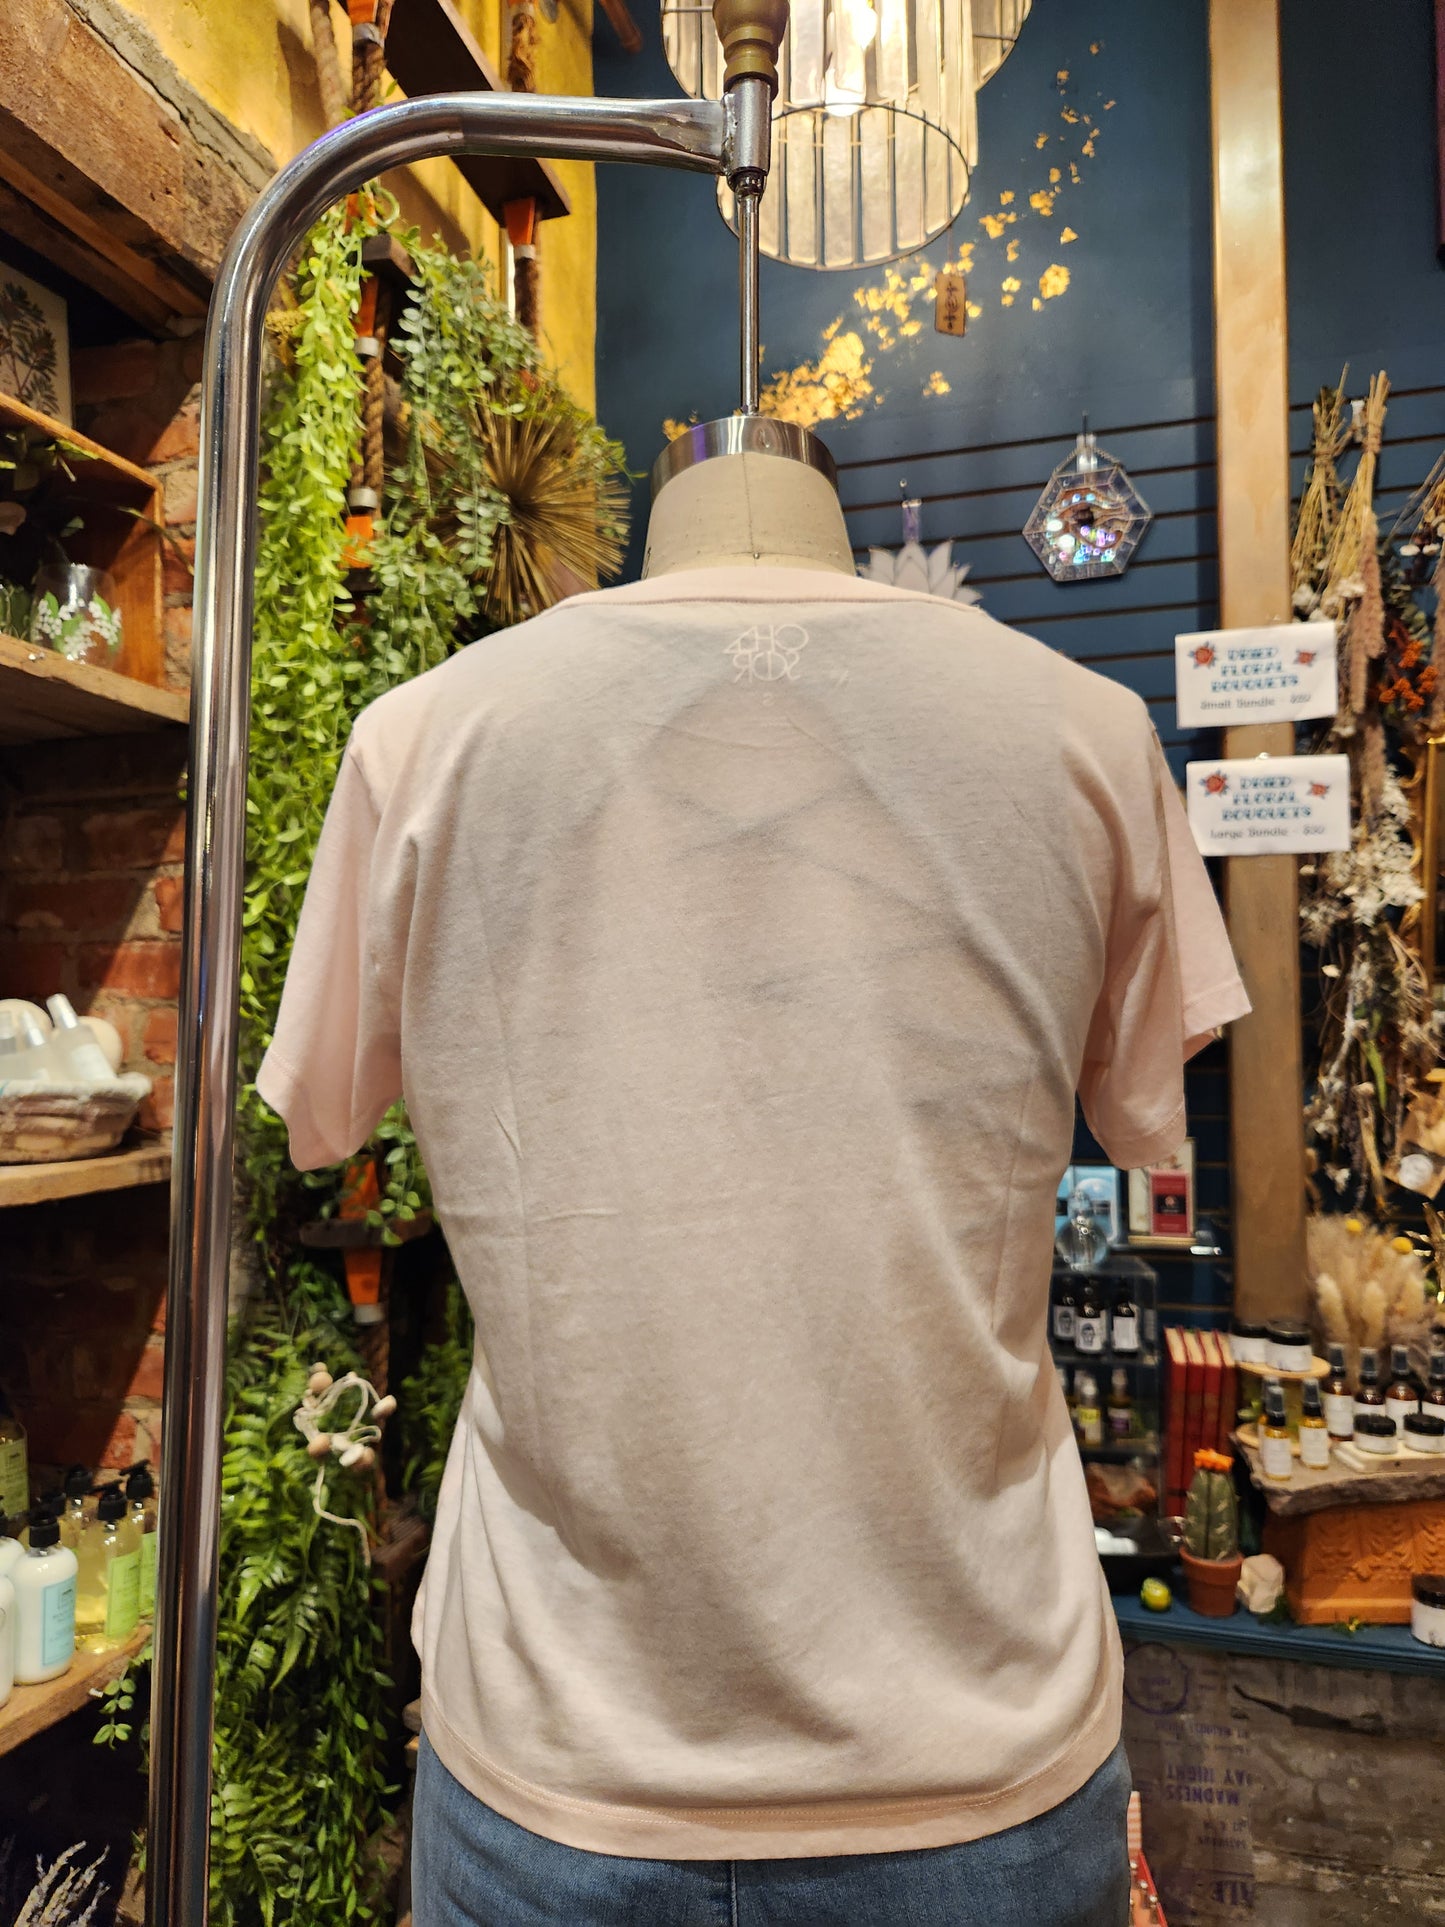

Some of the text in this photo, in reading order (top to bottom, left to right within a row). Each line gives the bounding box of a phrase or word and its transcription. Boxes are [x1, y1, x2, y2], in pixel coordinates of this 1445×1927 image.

[1211, 675, 1298, 692] BOUQUETS
[1200, 699, 1231, 710] Small
[1237, 697, 1275, 708] Bundle
[1240, 776, 1292, 789] DRIED
[1233, 792, 1297, 805] FLORAL
[1222, 806, 1312, 821] BOUQUETS
[1210, 829, 1242, 840] Large
[1248, 827, 1288, 837] Bundle
